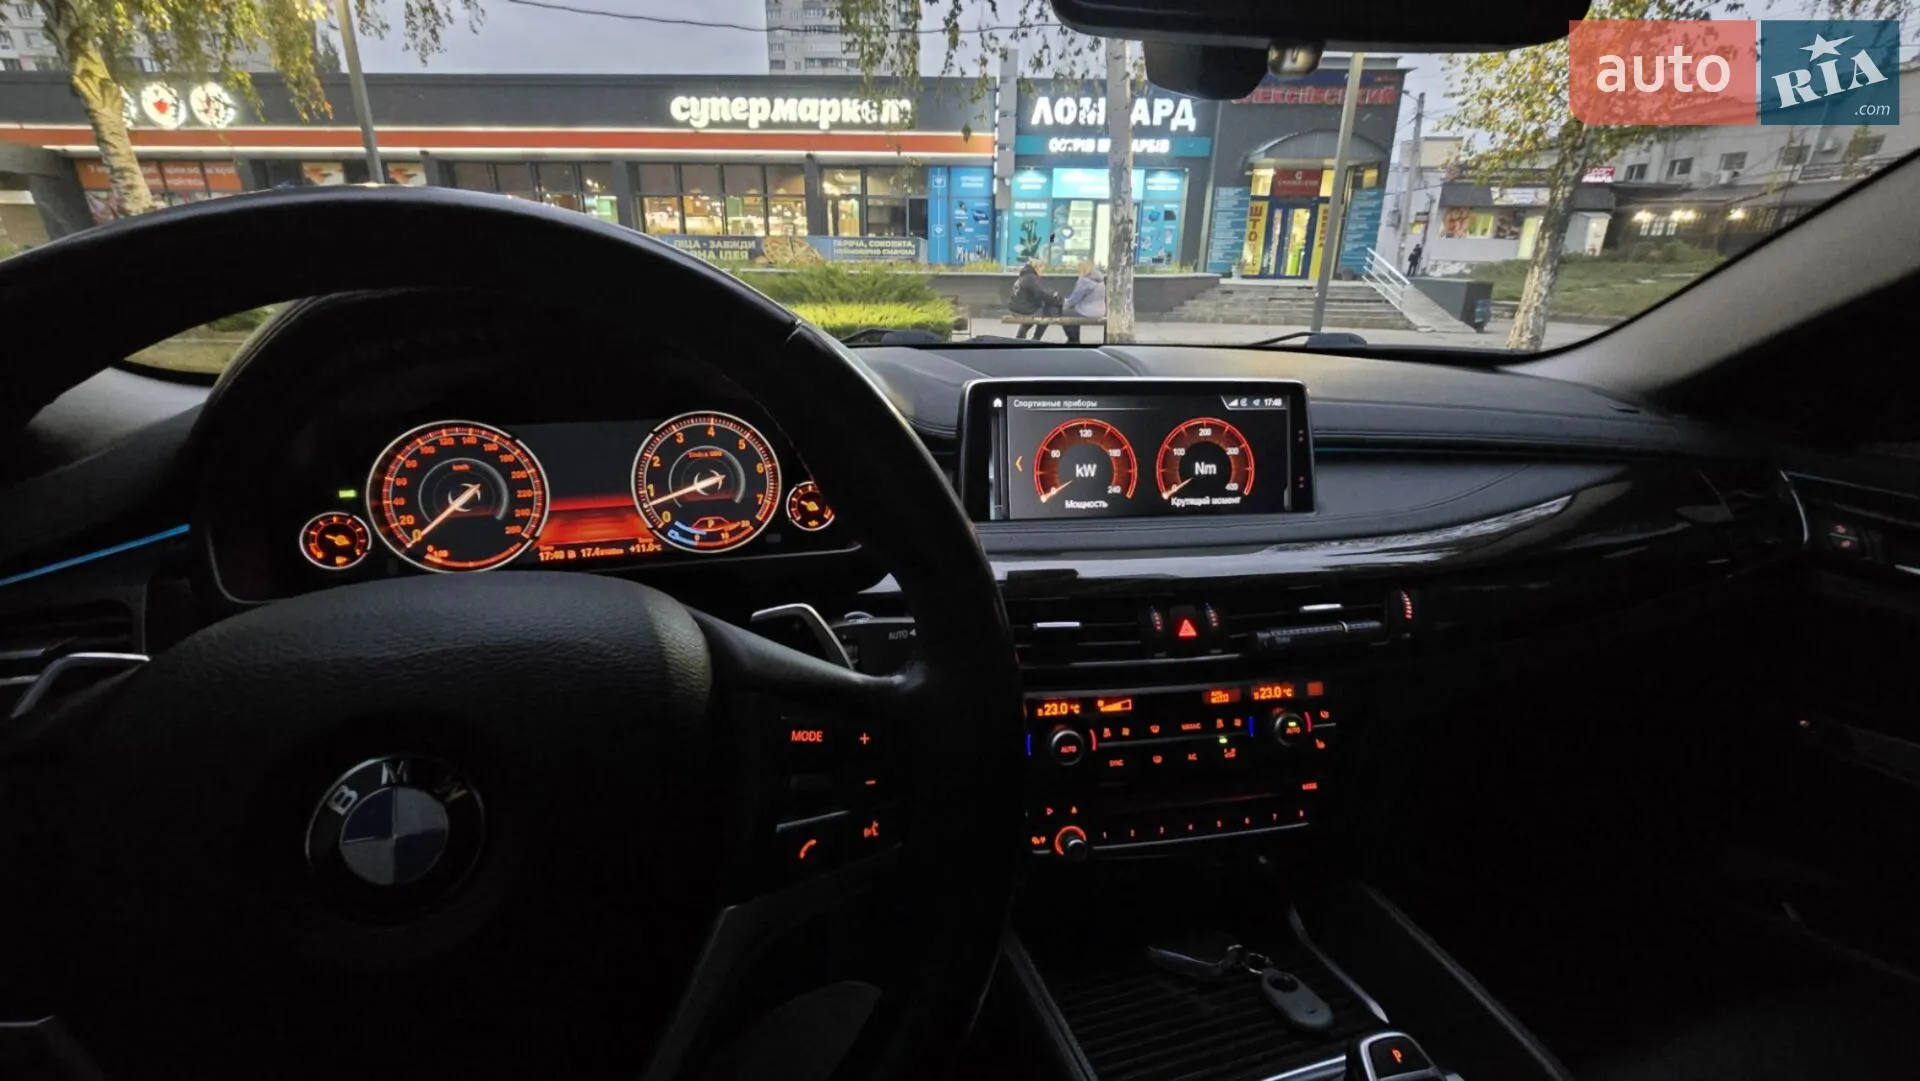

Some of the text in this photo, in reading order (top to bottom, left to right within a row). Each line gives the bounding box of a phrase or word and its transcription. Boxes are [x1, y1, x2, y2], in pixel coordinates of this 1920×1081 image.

[1031, 97, 1196, 132] ЛОМАРД
[1014, 399, 1098, 409] Спортивные приборы
[706, 426, 716, 437] 4
[1079, 429, 1093, 438] 120
[1198, 427, 1212, 436] 200
[676, 432, 684, 443] 3
[738, 440, 746, 450] 5
[1173, 447, 1186, 456] 100
[652, 456, 661, 467] 2
[756, 463, 764, 473] 6
[1075, 463, 1097, 478] kW
[1195, 461, 1217, 475] Nm
[648, 484, 655, 496] 1
[1107, 485, 1121, 494] 240
[756, 494, 764, 504] 7
[1065, 499, 1108, 509] Мощность
[1171, 496, 1241, 508] Крутящий момент
[400, 516, 414, 525] 20
[662, 511, 671, 522] 0
[888, 631, 908, 640] AUTO
[1260, 685, 1282, 700] 23.0
[1044, 702, 1069, 716] 23.0
[791, 730, 824, 742] MODE
[1392, 1049, 1402, 1063] P
